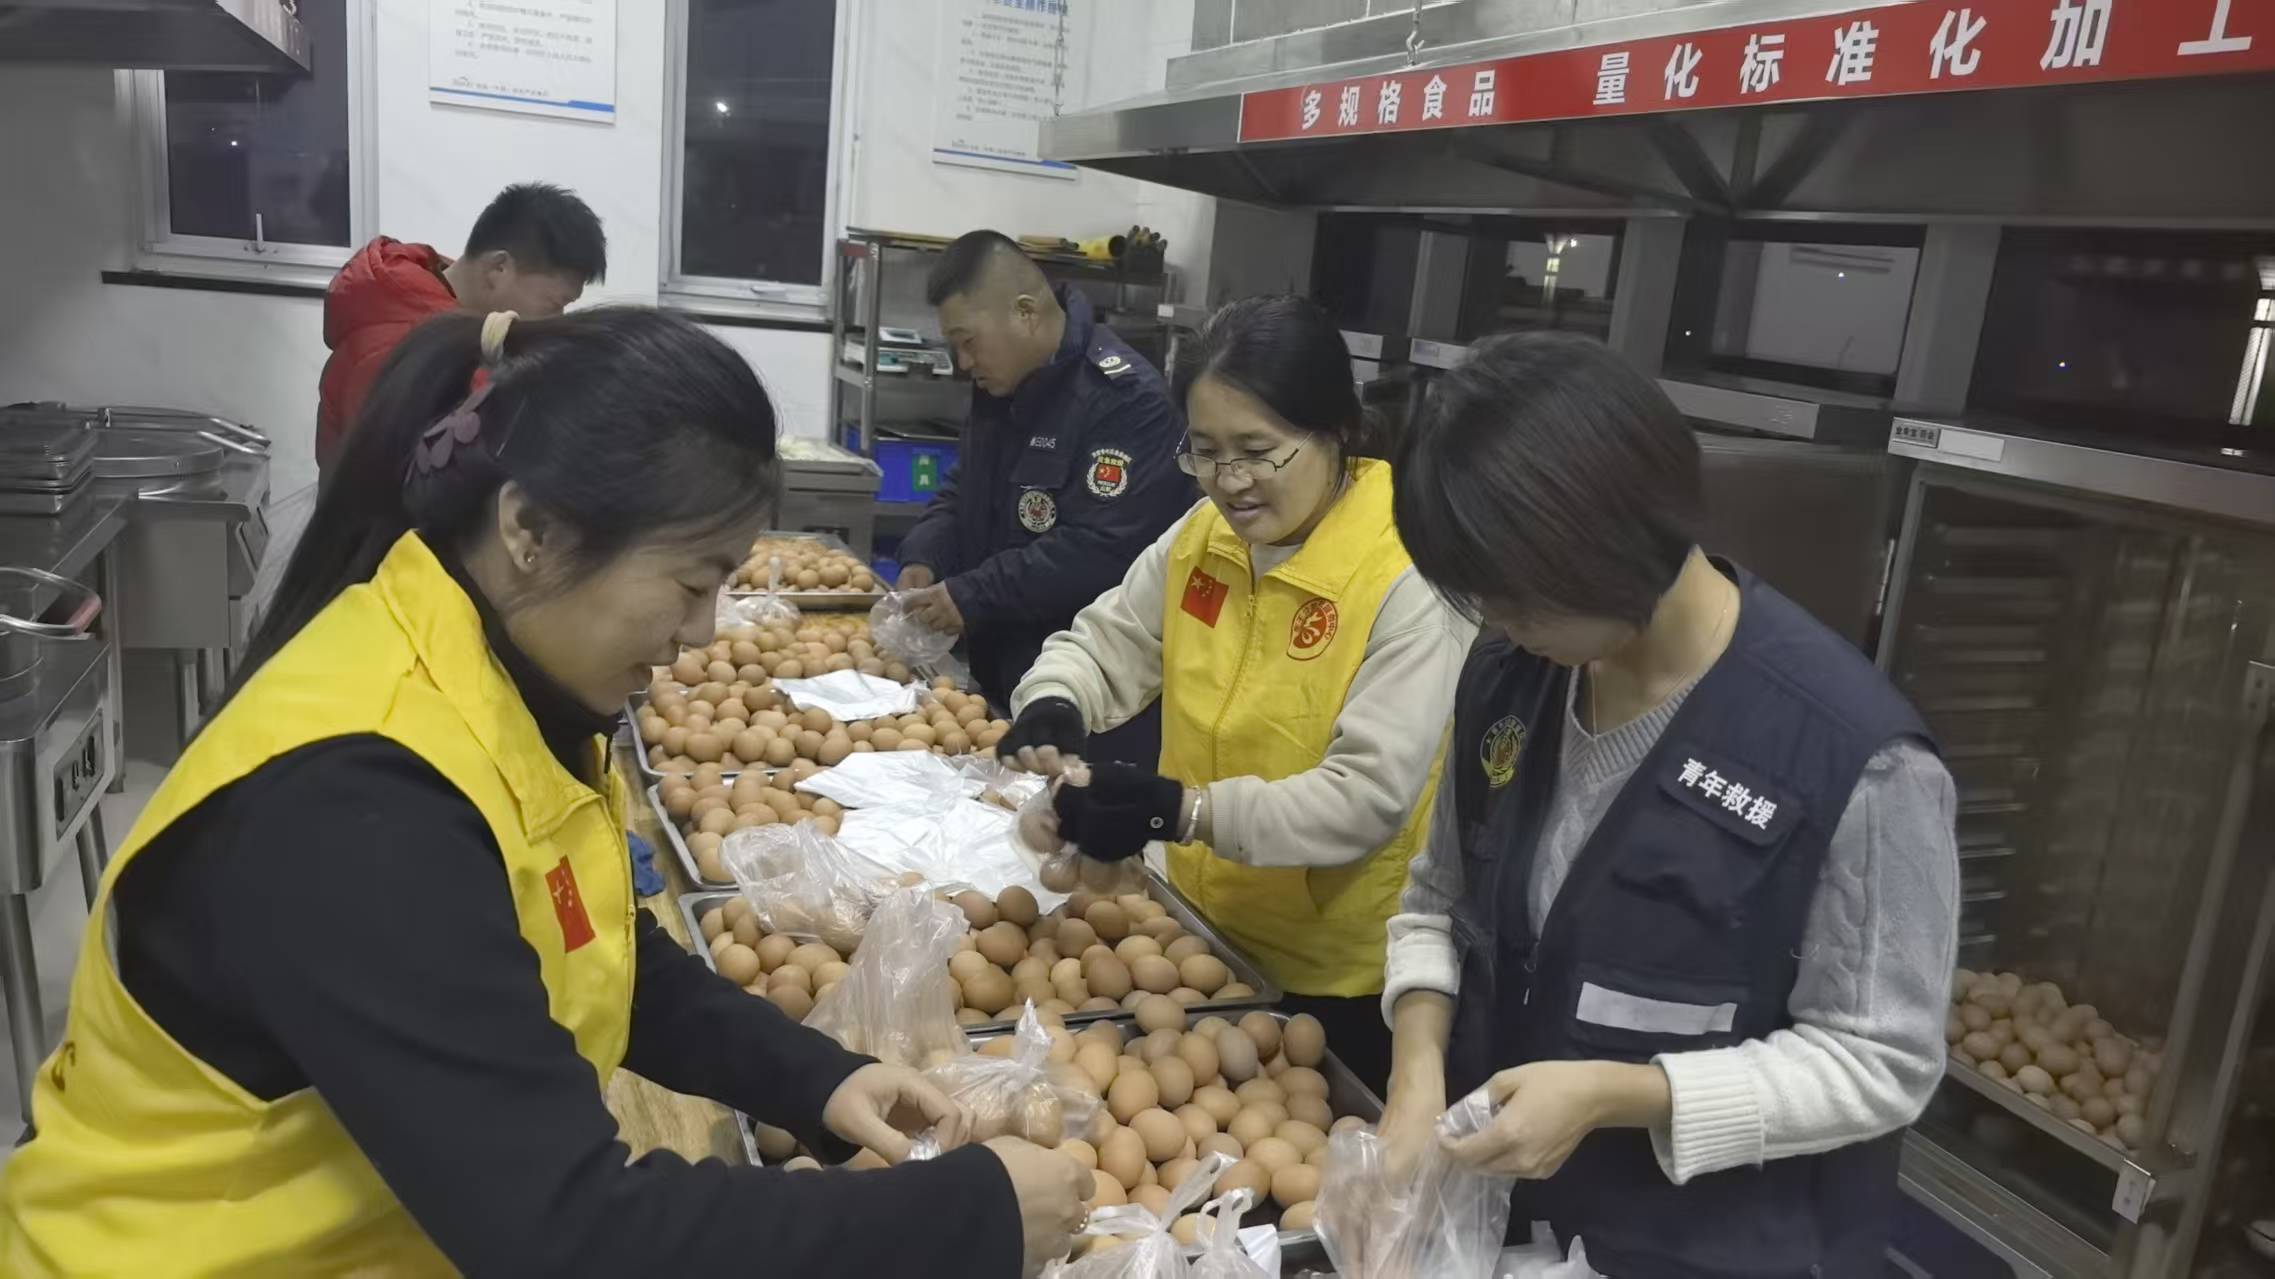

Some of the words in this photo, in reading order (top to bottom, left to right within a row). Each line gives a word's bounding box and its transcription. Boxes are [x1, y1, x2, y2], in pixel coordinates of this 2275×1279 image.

[1300, 70, 1496, 131] 多规格食品
[1594, 0, 2253, 105] 量化标准化加工
[1677, 757, 1777, 830] 青年救援
